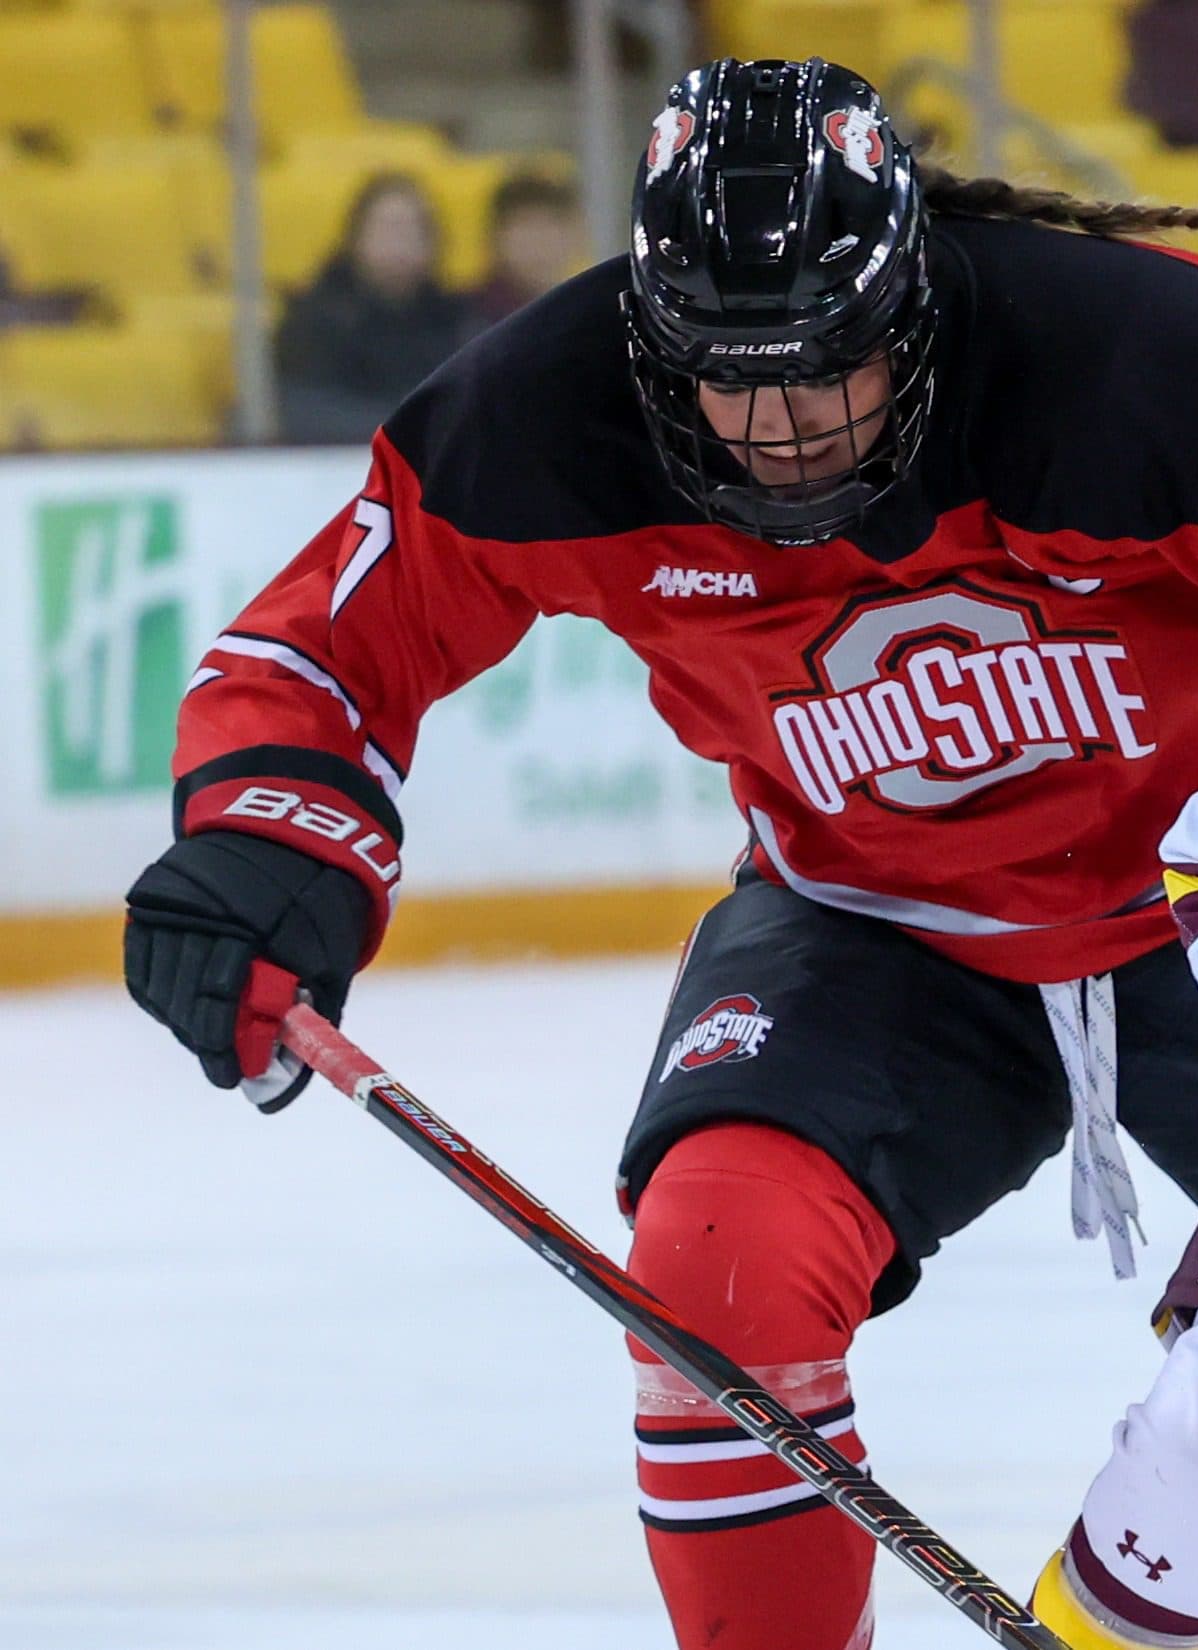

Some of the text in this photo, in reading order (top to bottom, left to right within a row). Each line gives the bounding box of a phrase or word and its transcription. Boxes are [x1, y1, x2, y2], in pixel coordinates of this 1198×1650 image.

[709, 341, 803, 356] BAUER
[328, 495, 395, 623] 7
[653, 566, 758, 598] WCHA
[222, 786, 401, 902] BAU
[379, 1089, 468, 1153] BAUER
[716, 1387, 1041, 1642] BAUER
